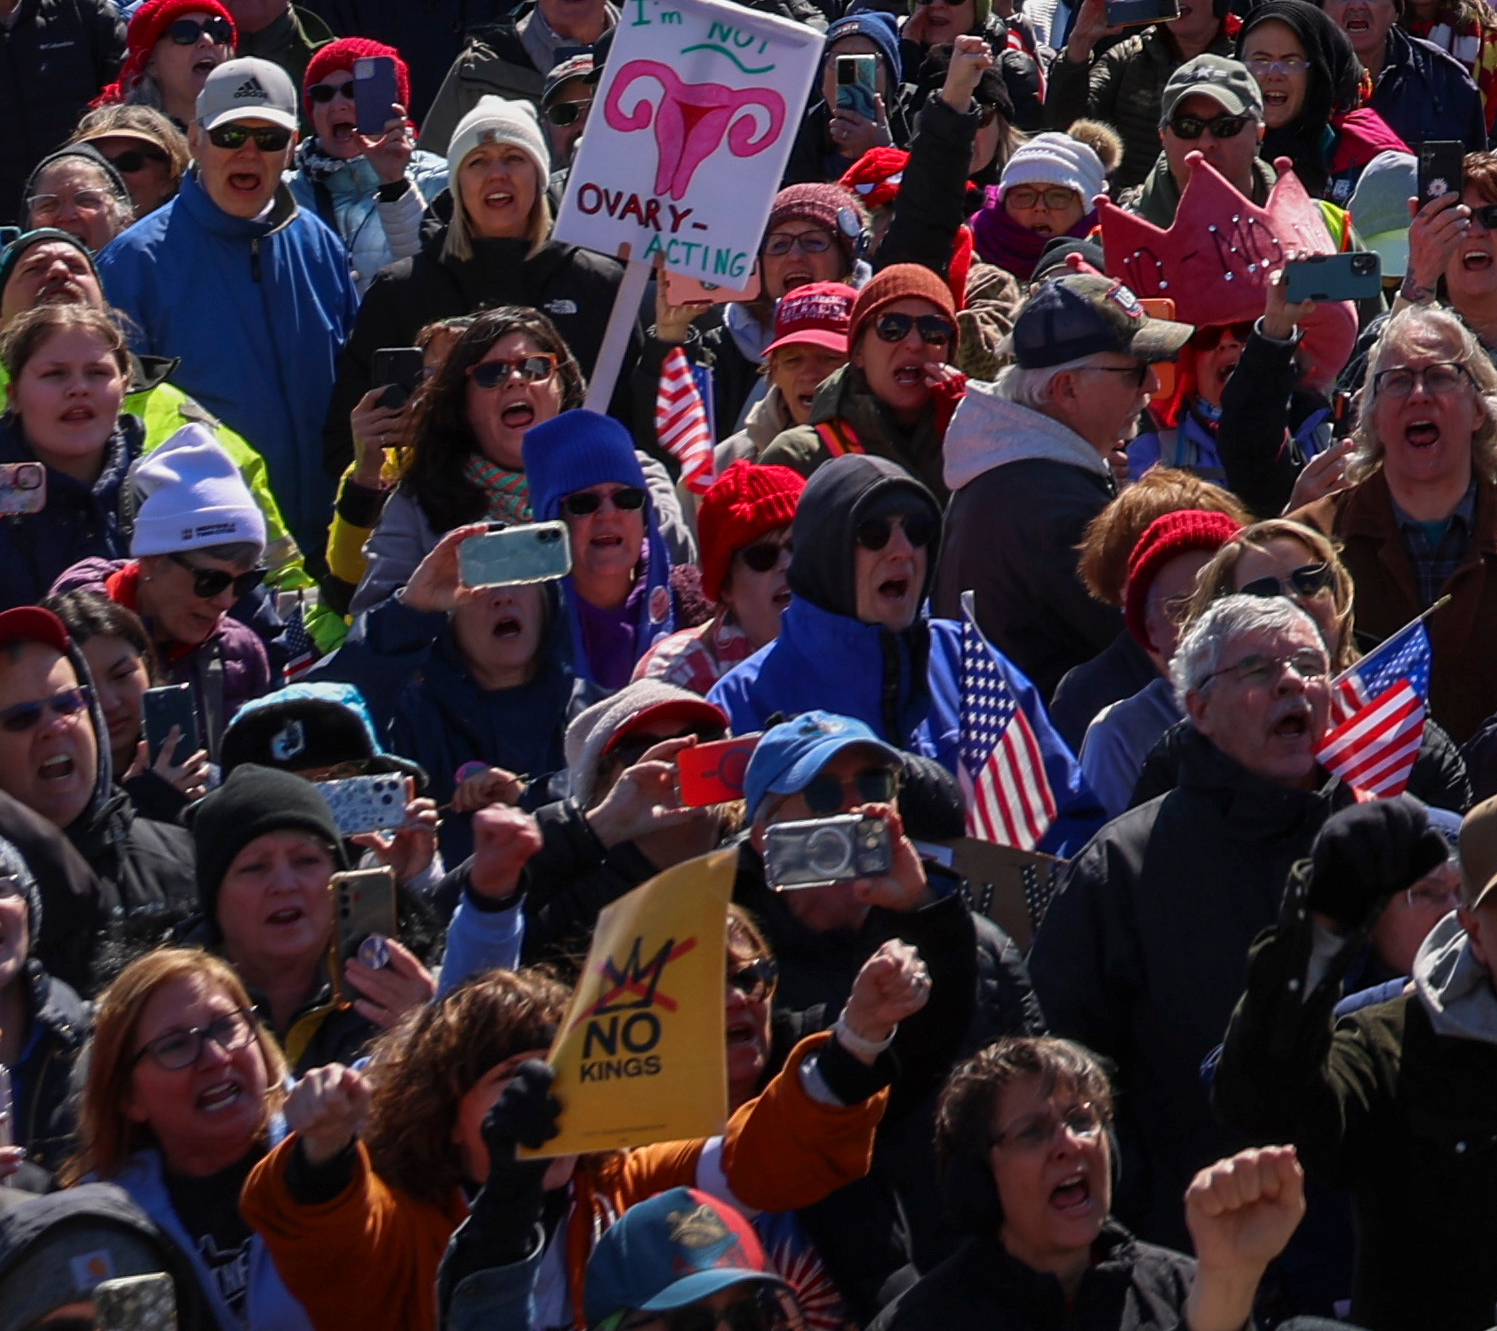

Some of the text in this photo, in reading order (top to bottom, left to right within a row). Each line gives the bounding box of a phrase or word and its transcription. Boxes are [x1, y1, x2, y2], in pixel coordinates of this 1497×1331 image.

[233, 89, 269, 99] adidas
[577, 182, 708, 234] OVARY-
[644, 237, 747, 279] ACTING
[584, 1014, 661, 1057] NO
[581, 1055, 662, 1081] KINGS
